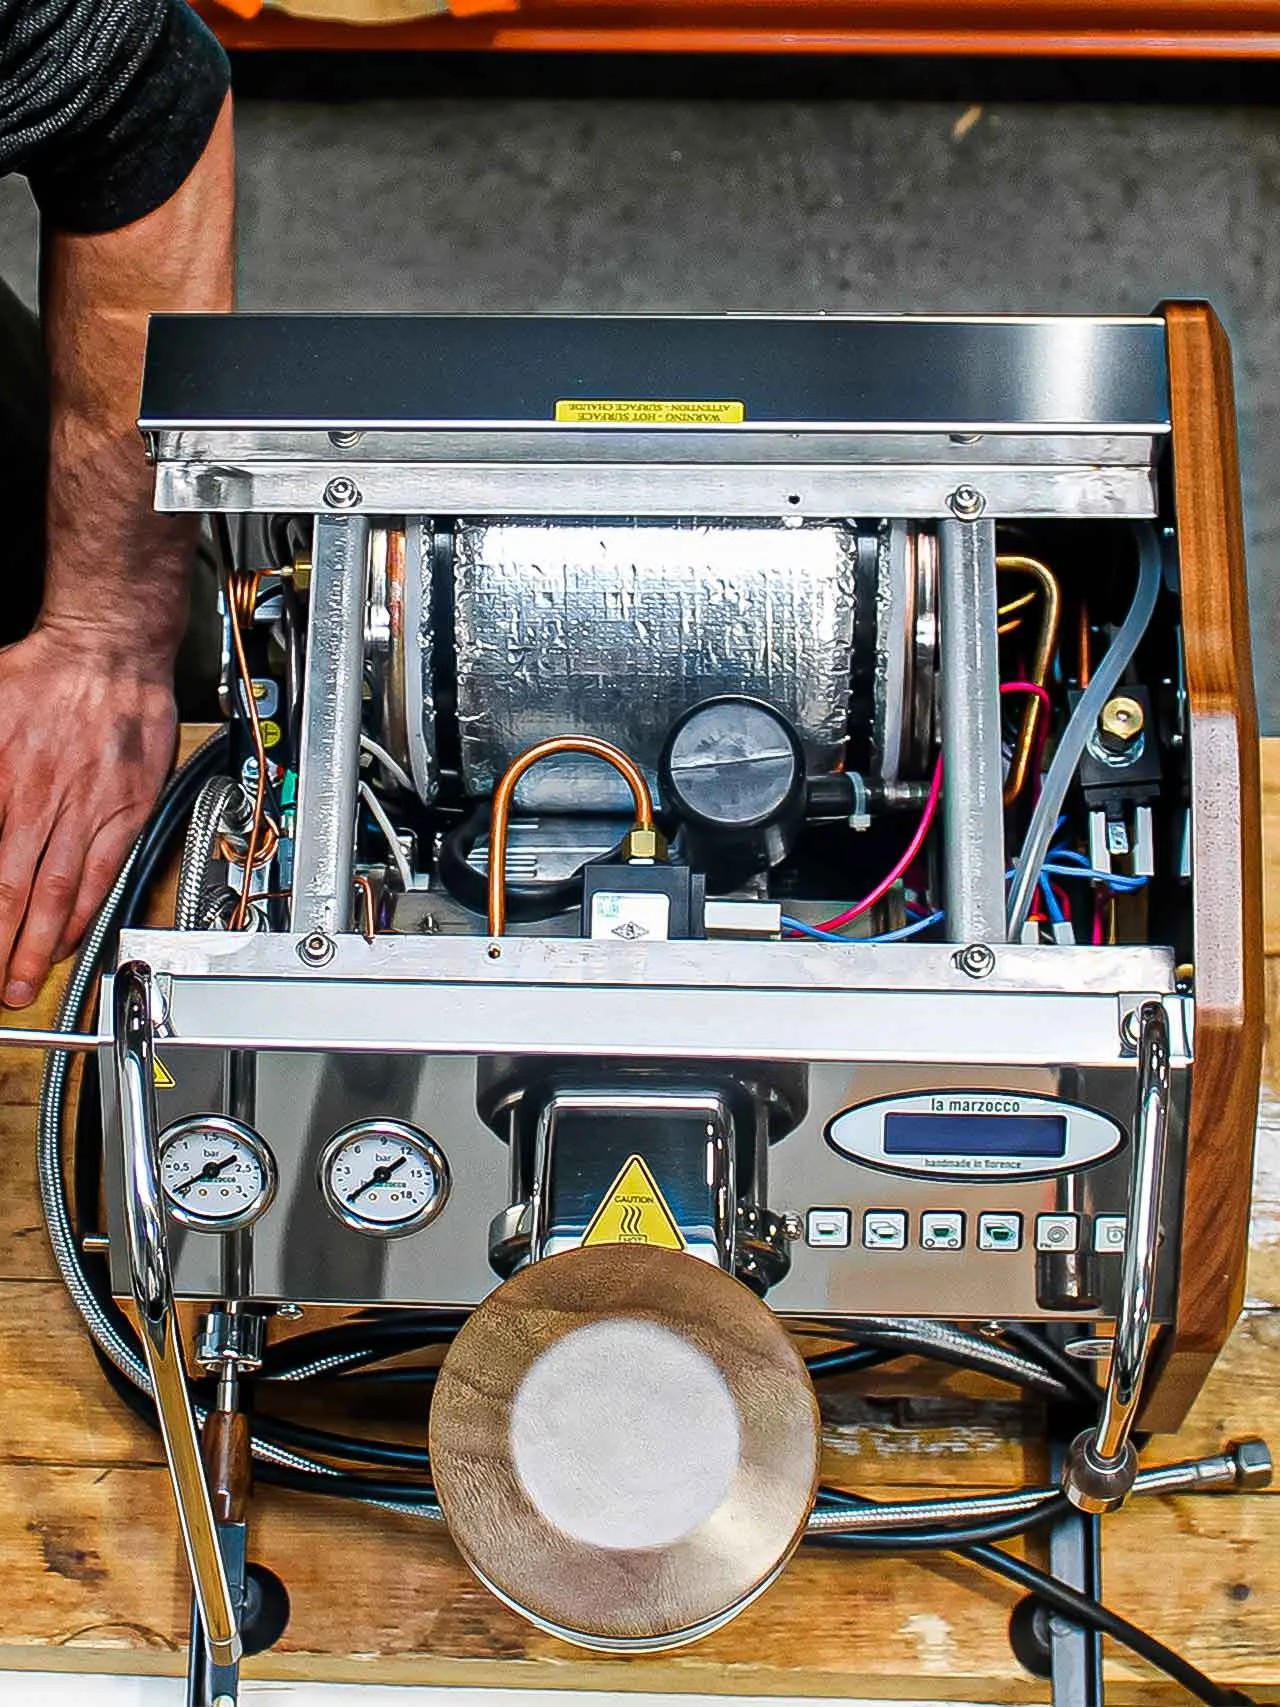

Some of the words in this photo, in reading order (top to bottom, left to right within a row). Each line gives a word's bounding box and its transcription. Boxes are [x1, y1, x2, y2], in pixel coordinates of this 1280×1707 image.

[616, 404, 663, 412] SURFACE
[671, 404, 731, 412] ATTENTION
[577, 413, 630, 421] SURFACE
[633, 413, 656, 421] HOT
[665, 413, 721, 422] WARNING
[931, 1098, 944, 1112] la
[949, 1100, 1020, 1113] marzocco
[380, 1136, 388, 1145] 9
[232, 1141, 240, 1150] 2
[354, 1145, 362, 1154] 6
[203, 1149, 220, 1157] bar
[401, 1146, 413, 1155] 12
[375, 1153, 392, 1162] bar
[924, 1158, 971, 1168] handmade
[974, 1159, 982, 1168] in
[343, 1166, 351, 1175] 3
[410, 1169, 423, 1178] 15
[235, 1185, 242, 1193] 3
[400, 1190, 413, 1199] 18
[615, 1195, 654, 1204] CAUTION
